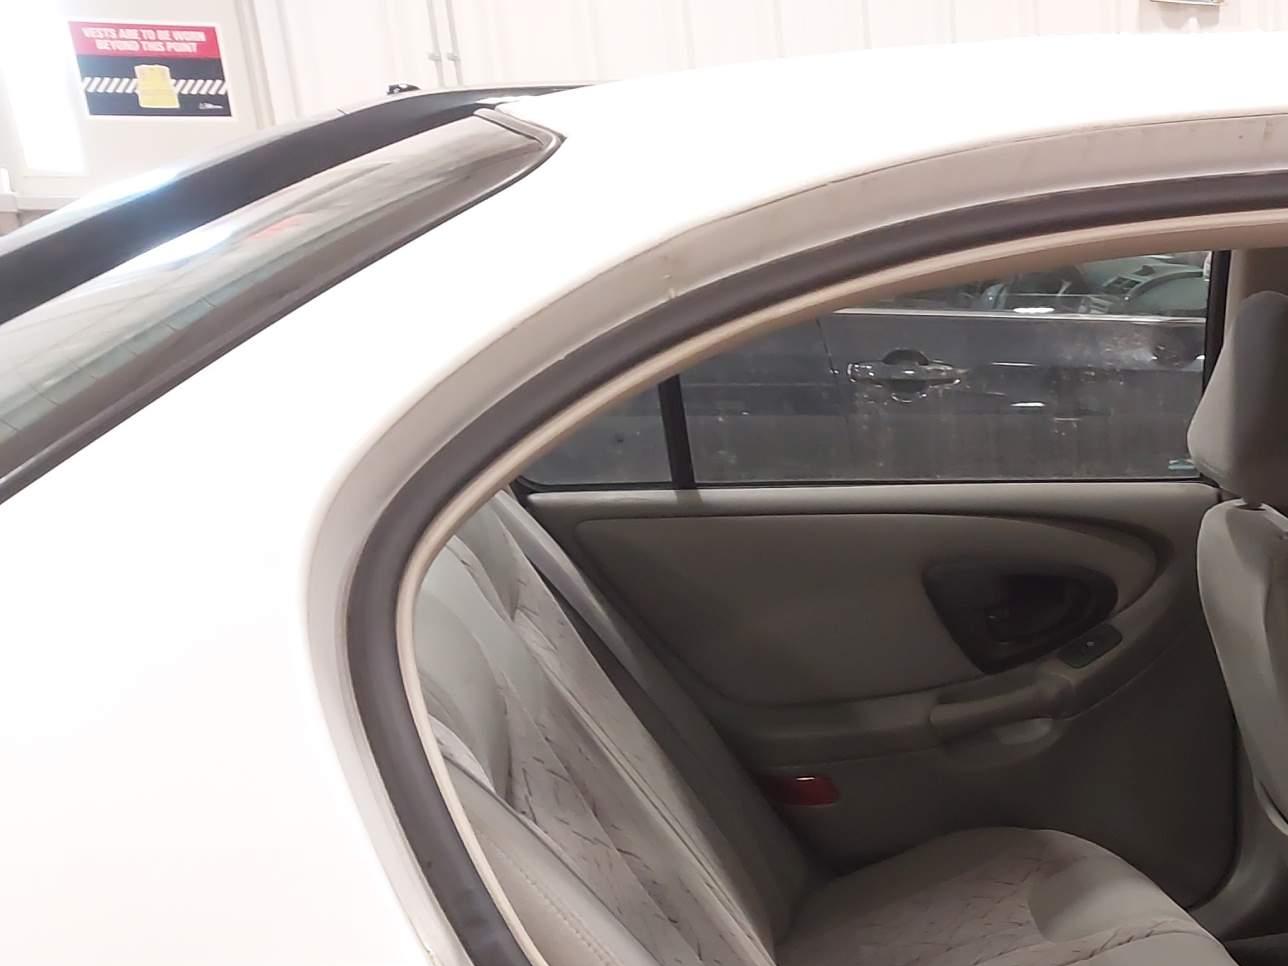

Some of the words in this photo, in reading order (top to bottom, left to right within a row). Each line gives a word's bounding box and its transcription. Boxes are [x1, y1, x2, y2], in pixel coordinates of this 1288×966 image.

[81, 27, 118, 40] VESTS
[118, 28, 139, 41] ARE
[140, 29, 156, 41] TO
[156, 30, 171, 42] BE
[172, 31, 206, 43] WORN
[95, 39, 140, 51] BEYOND
[140, 41, 165, 52] THIS
[165, 42, 197, 53] POINT
